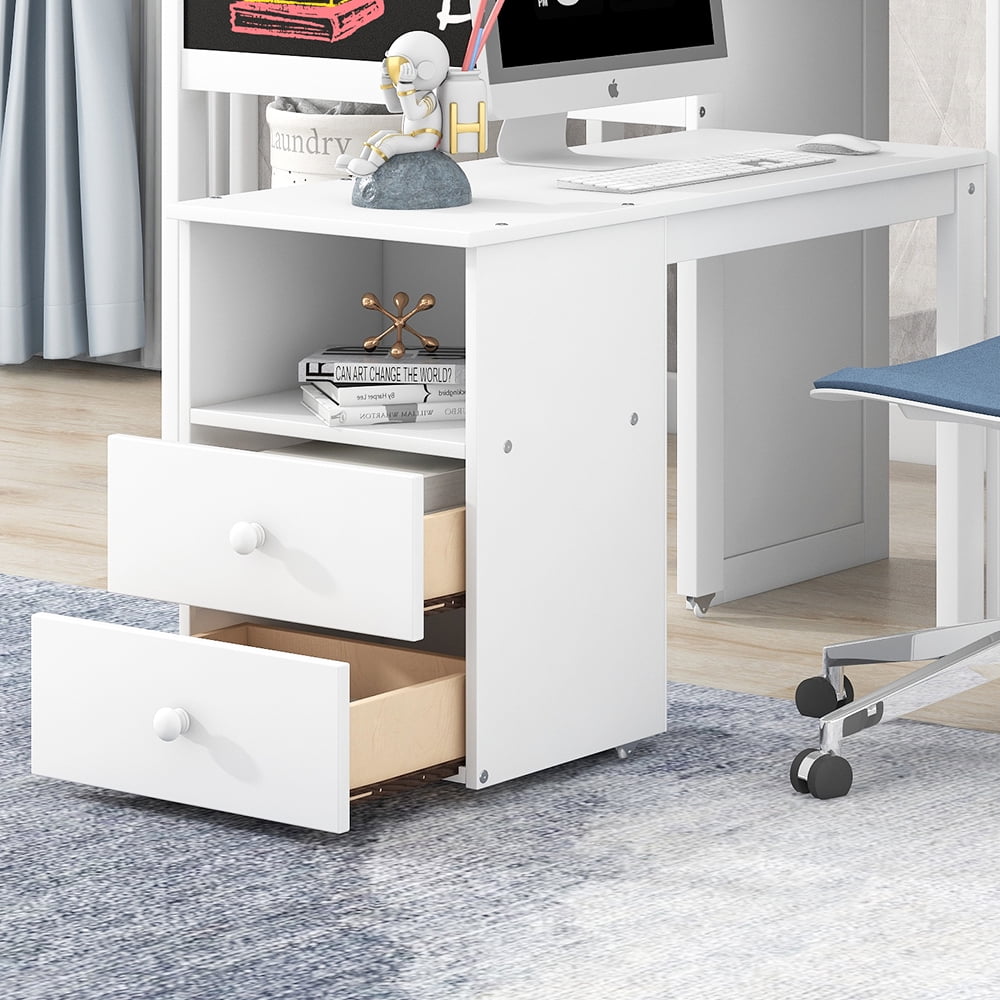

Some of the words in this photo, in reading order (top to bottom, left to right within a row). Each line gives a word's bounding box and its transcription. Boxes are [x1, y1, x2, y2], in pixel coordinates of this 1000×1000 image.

[450, 101, 487, 155] H
[335, 365, 351, 381] CAN
[353, 366, 368, 381] ART
[369, 366, 401, 382] CHANGE
[403, 367, 418, 382] THE
[420, 367, 452, 383] WORLD?
